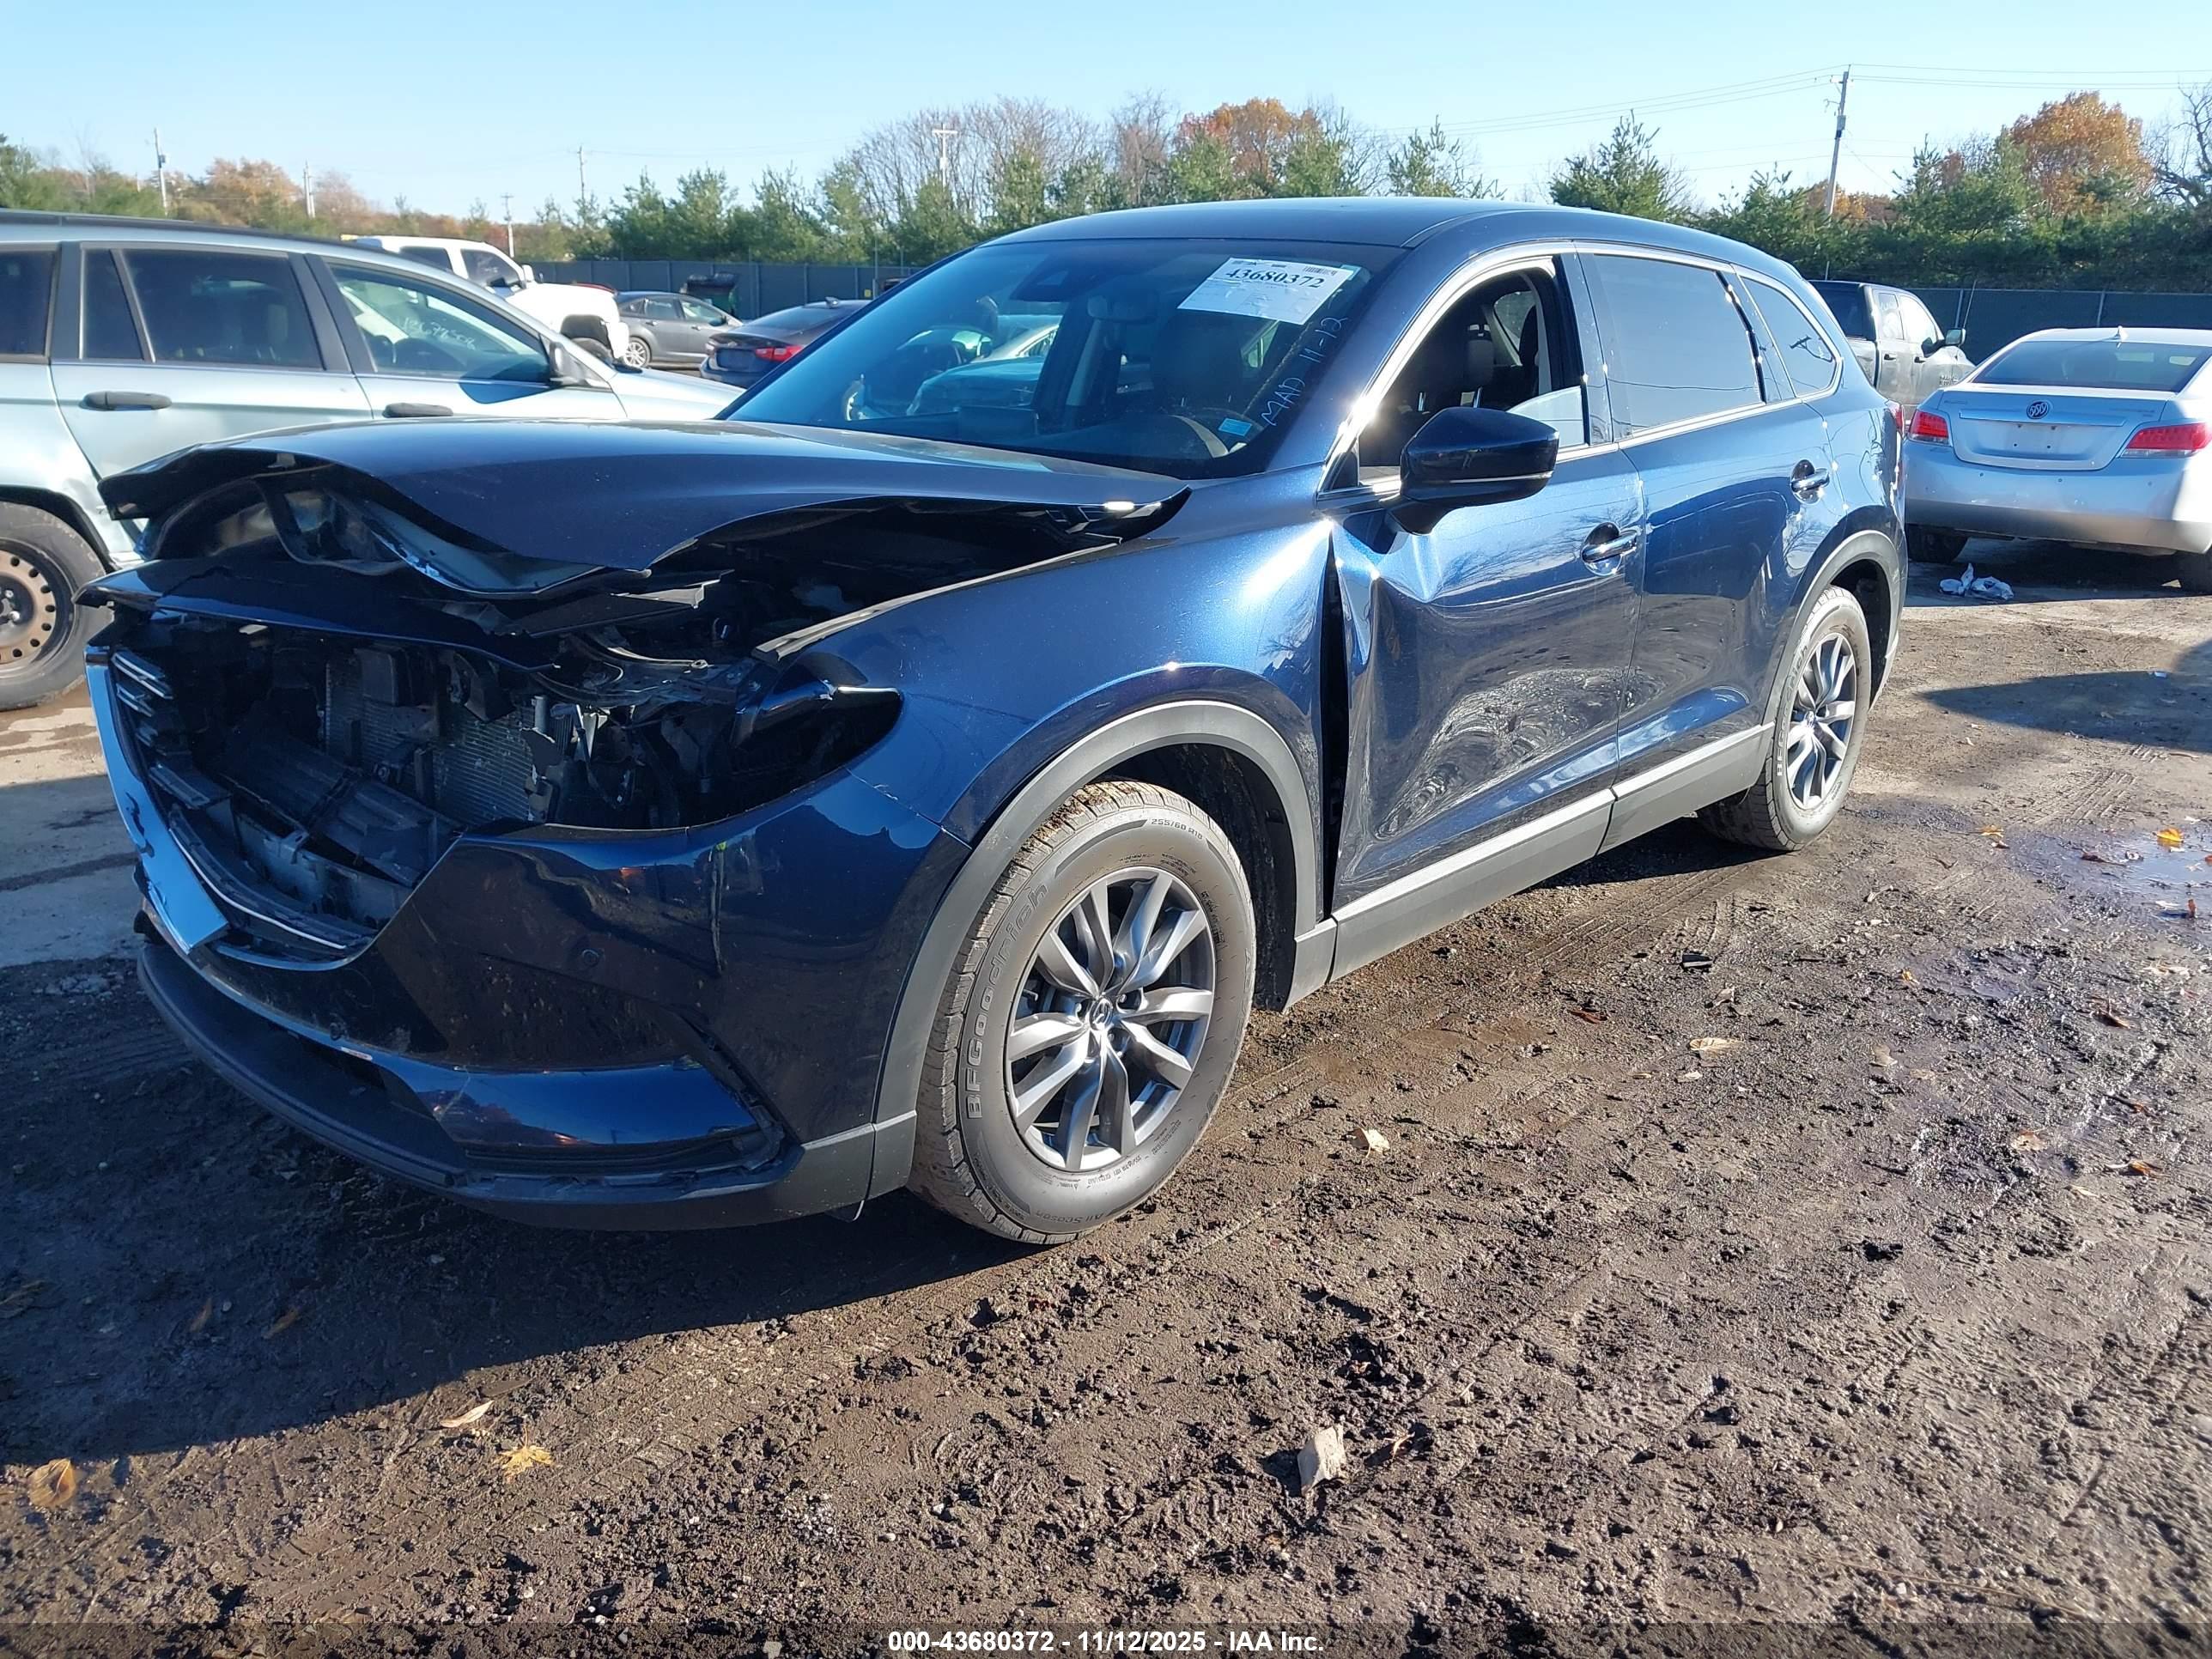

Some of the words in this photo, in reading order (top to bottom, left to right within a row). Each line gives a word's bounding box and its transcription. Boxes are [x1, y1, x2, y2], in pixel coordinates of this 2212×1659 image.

[1226, 269, 1325, 289] 43680372
[1299, 317, 1349, 364] 11-12
[1152, 818, 1187, 830] 255/60
[965, 882, 1049, 1120] BFGoodrich
